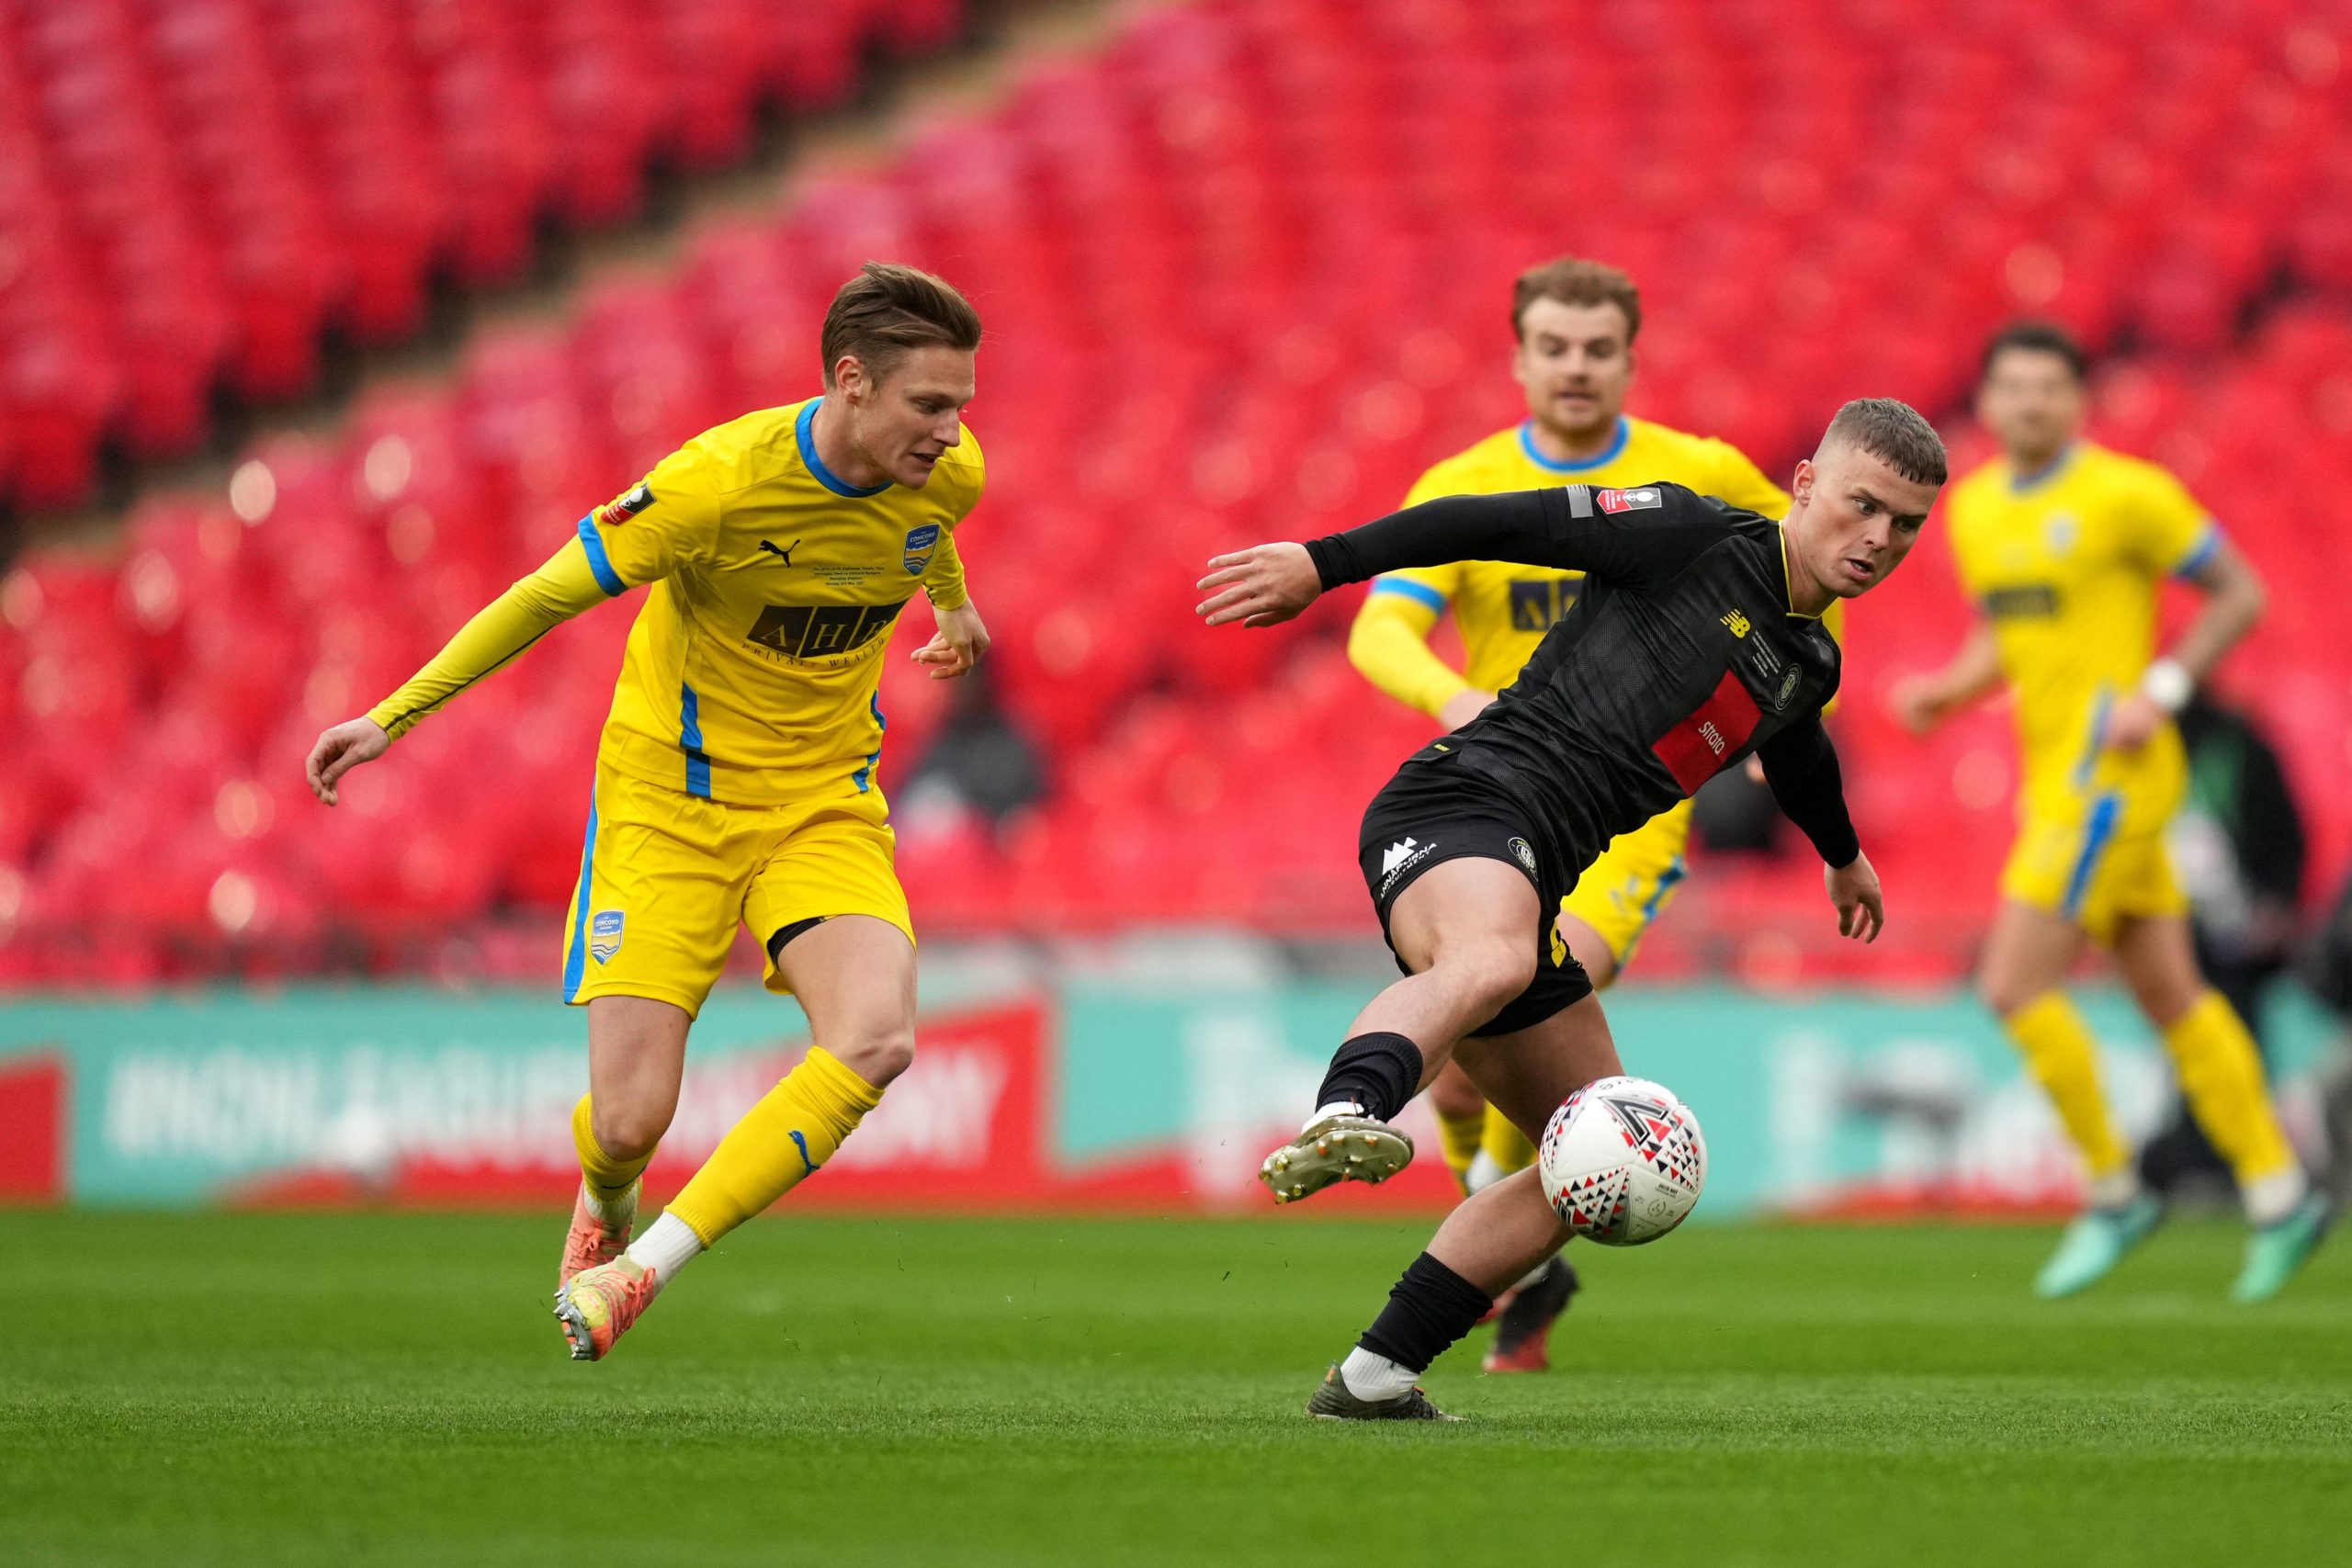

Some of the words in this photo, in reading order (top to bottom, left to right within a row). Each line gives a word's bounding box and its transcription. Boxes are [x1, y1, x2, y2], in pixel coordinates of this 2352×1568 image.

[910, 532, 935, 543] CONCORD
[829, 637, 886, 668] WEALTH
[1698, 721, 1725, 756] strata
